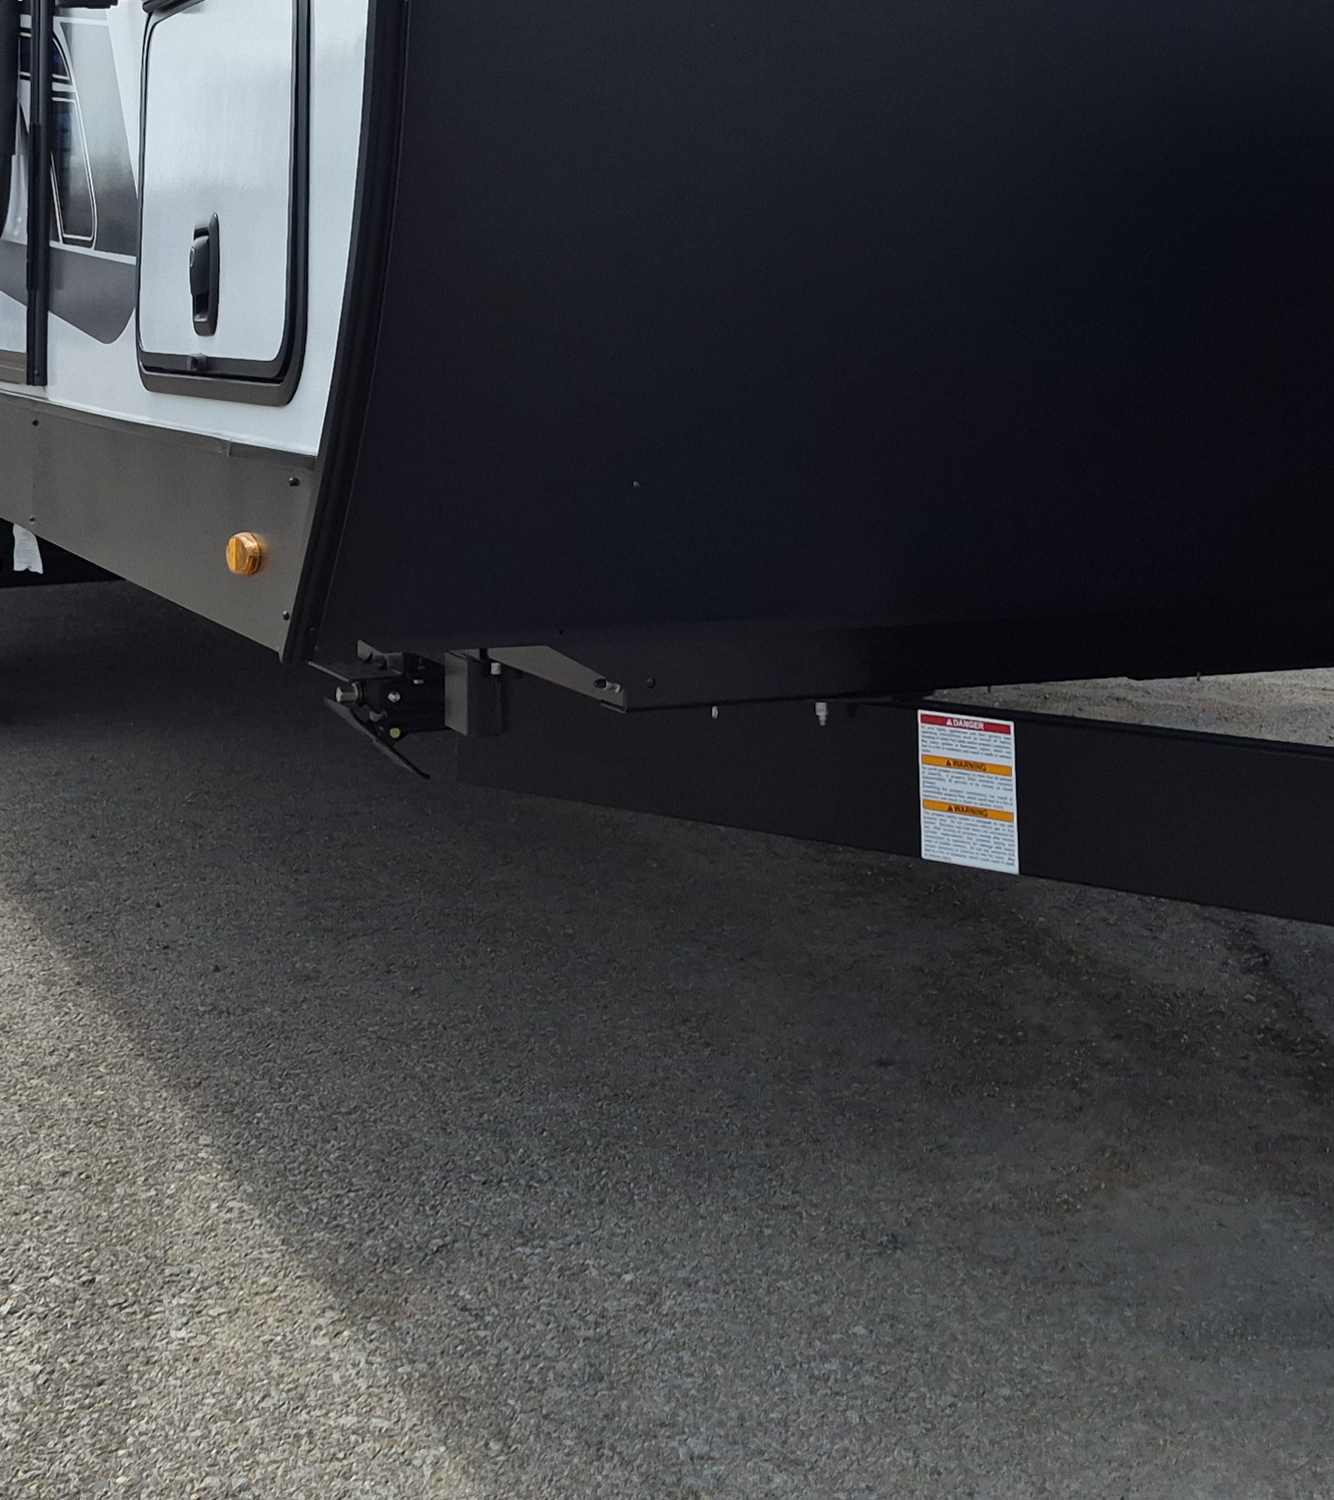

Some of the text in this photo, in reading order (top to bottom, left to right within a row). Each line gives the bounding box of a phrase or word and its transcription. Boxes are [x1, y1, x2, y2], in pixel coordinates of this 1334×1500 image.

[953, 719, 984, 731] DANGER
[952, 759, 987, 772] WARNING
[953, 804, 988, 817] WARNING
